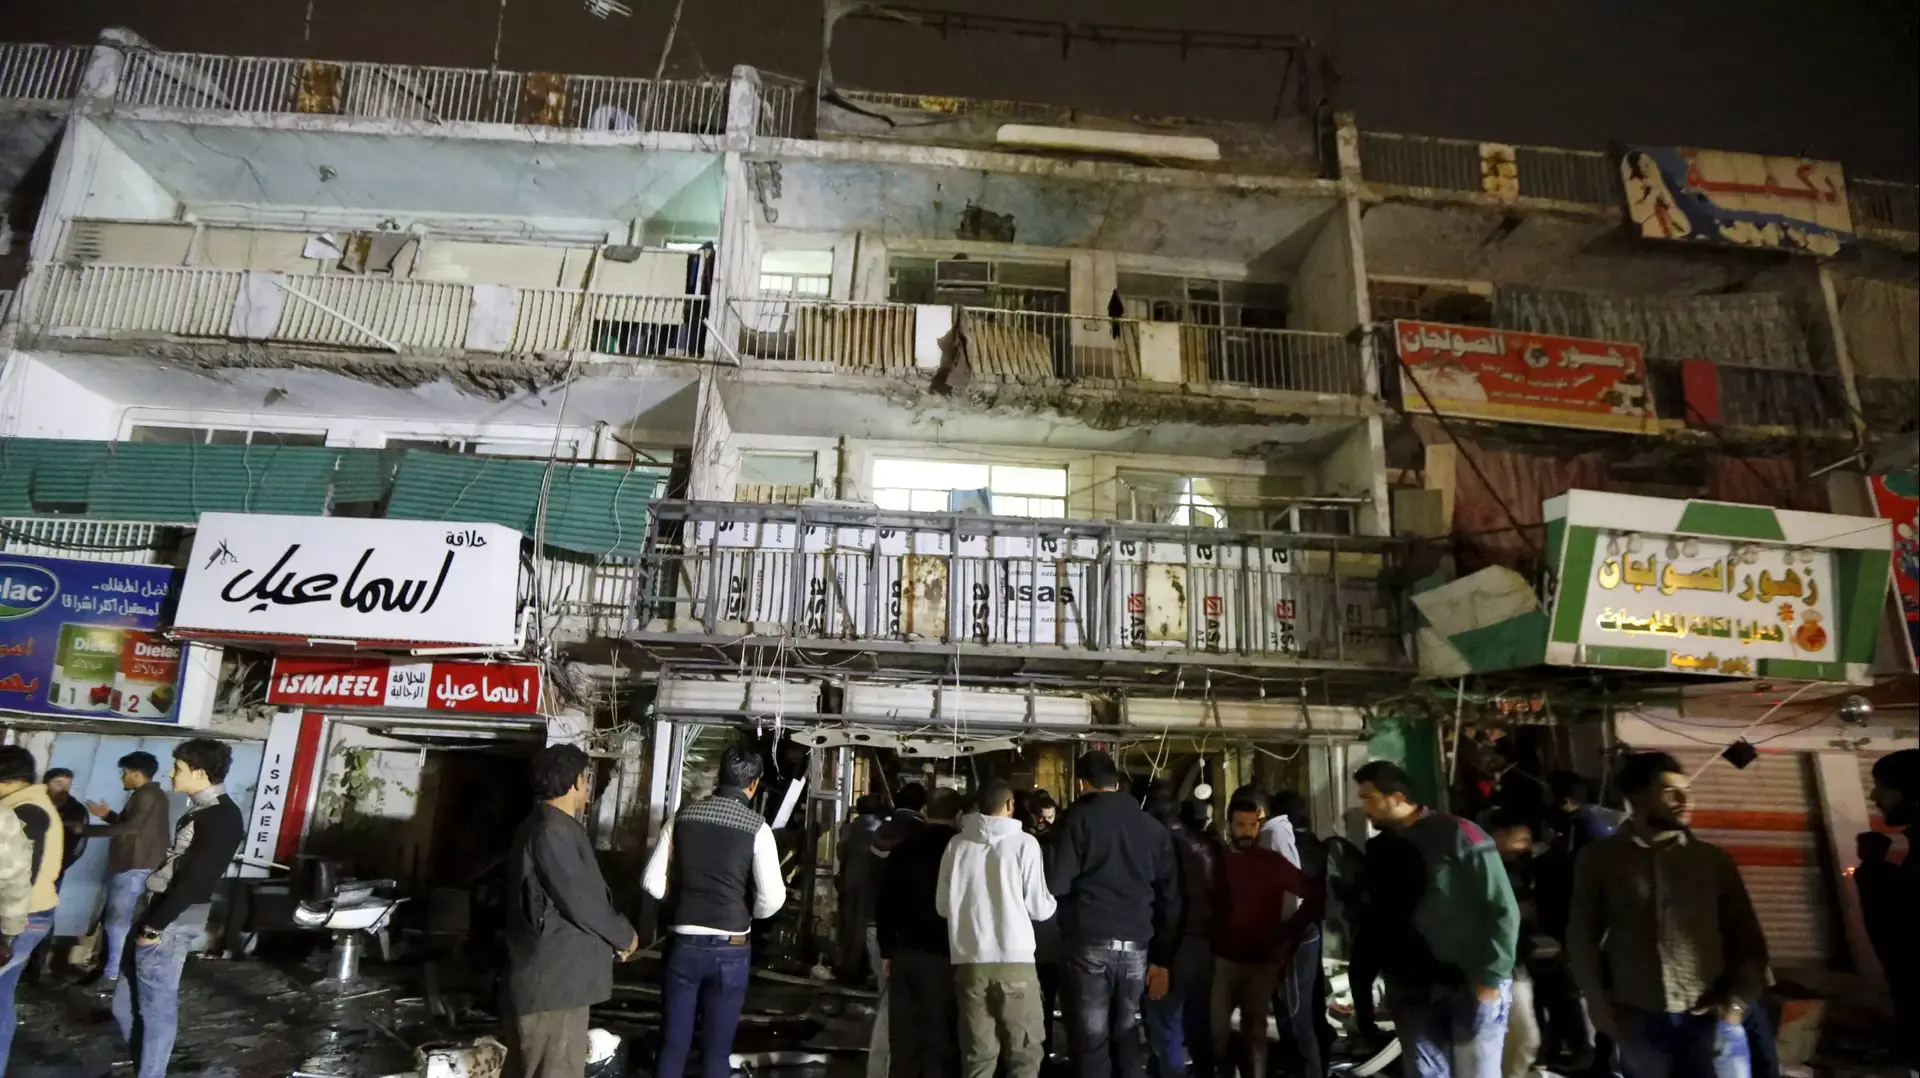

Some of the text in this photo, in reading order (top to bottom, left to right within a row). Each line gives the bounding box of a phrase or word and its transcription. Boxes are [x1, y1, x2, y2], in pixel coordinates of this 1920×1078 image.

[1403, 327, 1506, 356] الصولجان
[446, 531, 487, 547] حلاقة
[0, 577, 43, 602] lac
[221, 544, 455, 613] اسماعيل
[1598, 551, 1818, 606] زهور الصولجان
[135, 642, 181, 658] Dielac
[392, 670, 426, 684] للحلاقة
[128, 694, 140, 712] 2
[390, 686, 424, 700] الرجالية
[436, 675, 530, 706] اسماعيل
[254, 754, 280, 858] ISMAEEL
